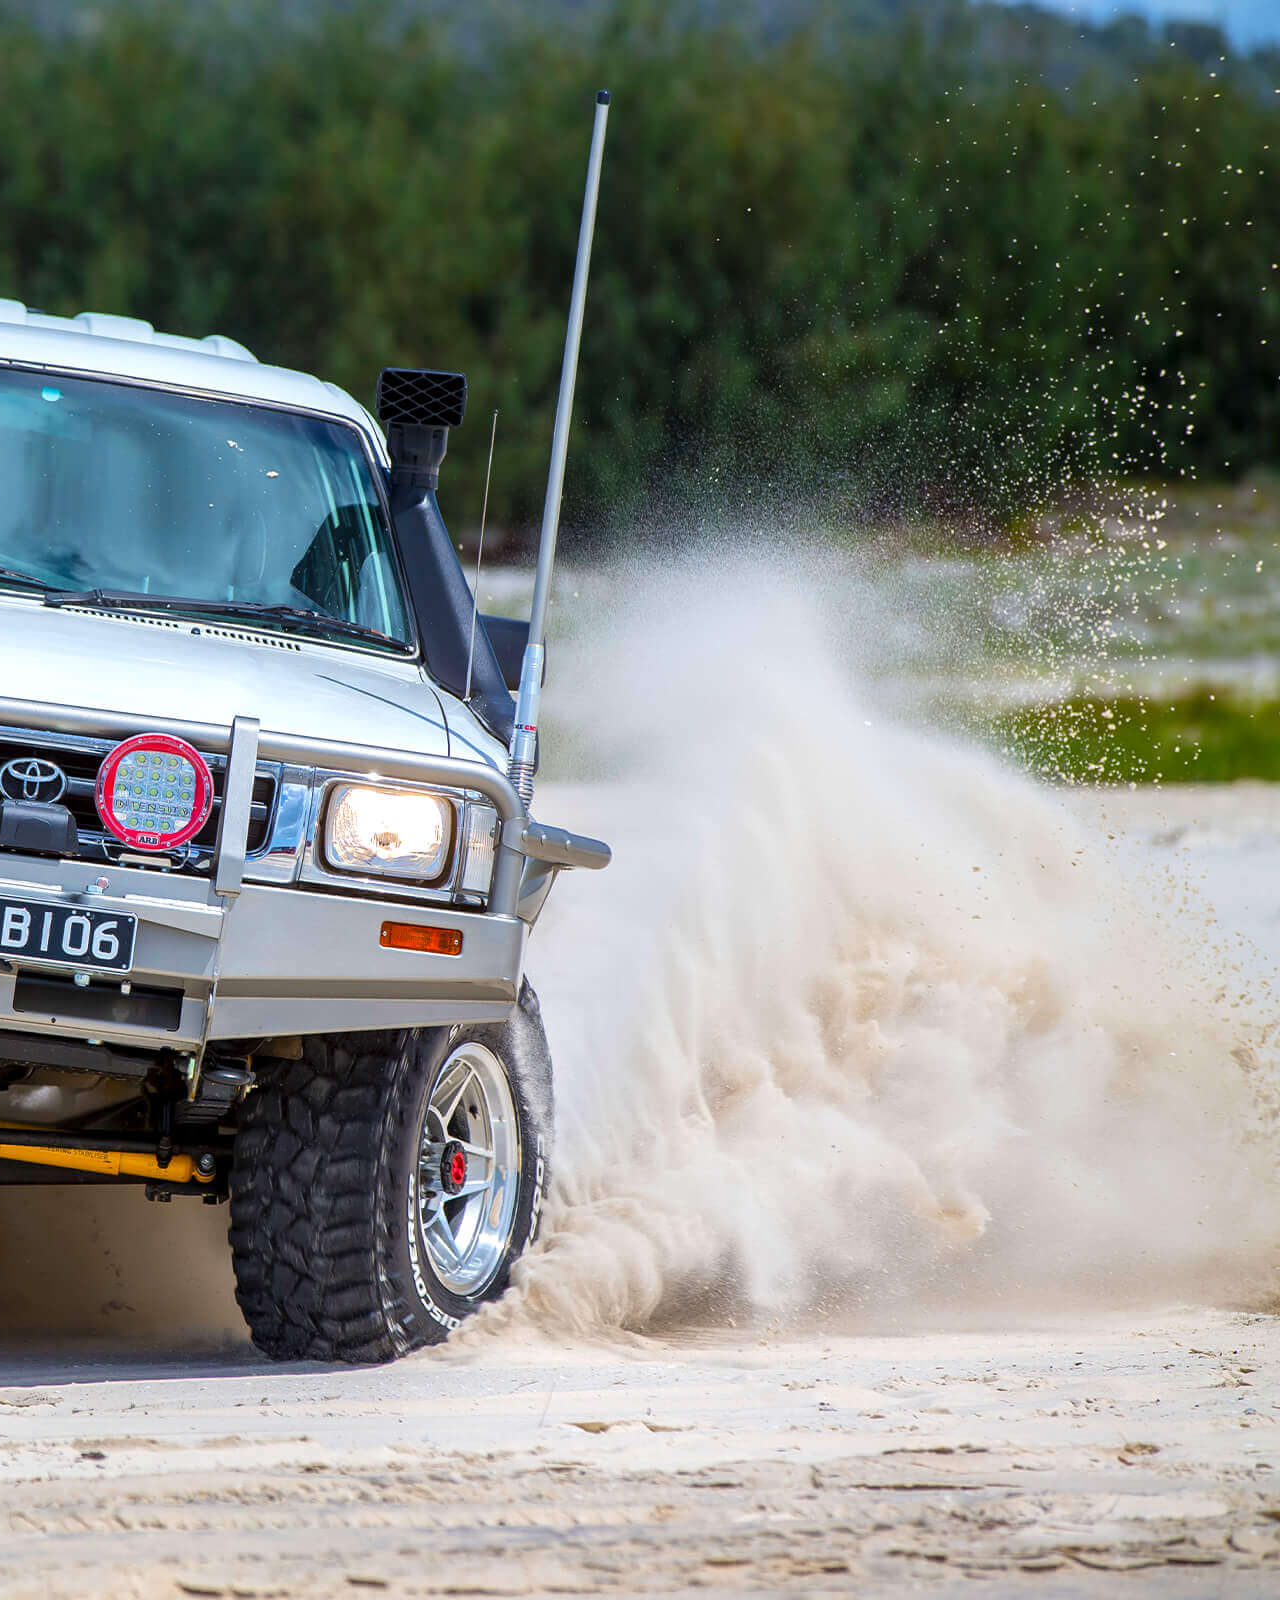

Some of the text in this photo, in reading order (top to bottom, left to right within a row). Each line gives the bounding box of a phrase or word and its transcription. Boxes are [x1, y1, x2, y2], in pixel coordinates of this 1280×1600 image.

[138, 836, 158, 845] ARB
[407, 1172, 462, 1331] DISCOVERER
[521, 1133, 545, 1256] COOP
